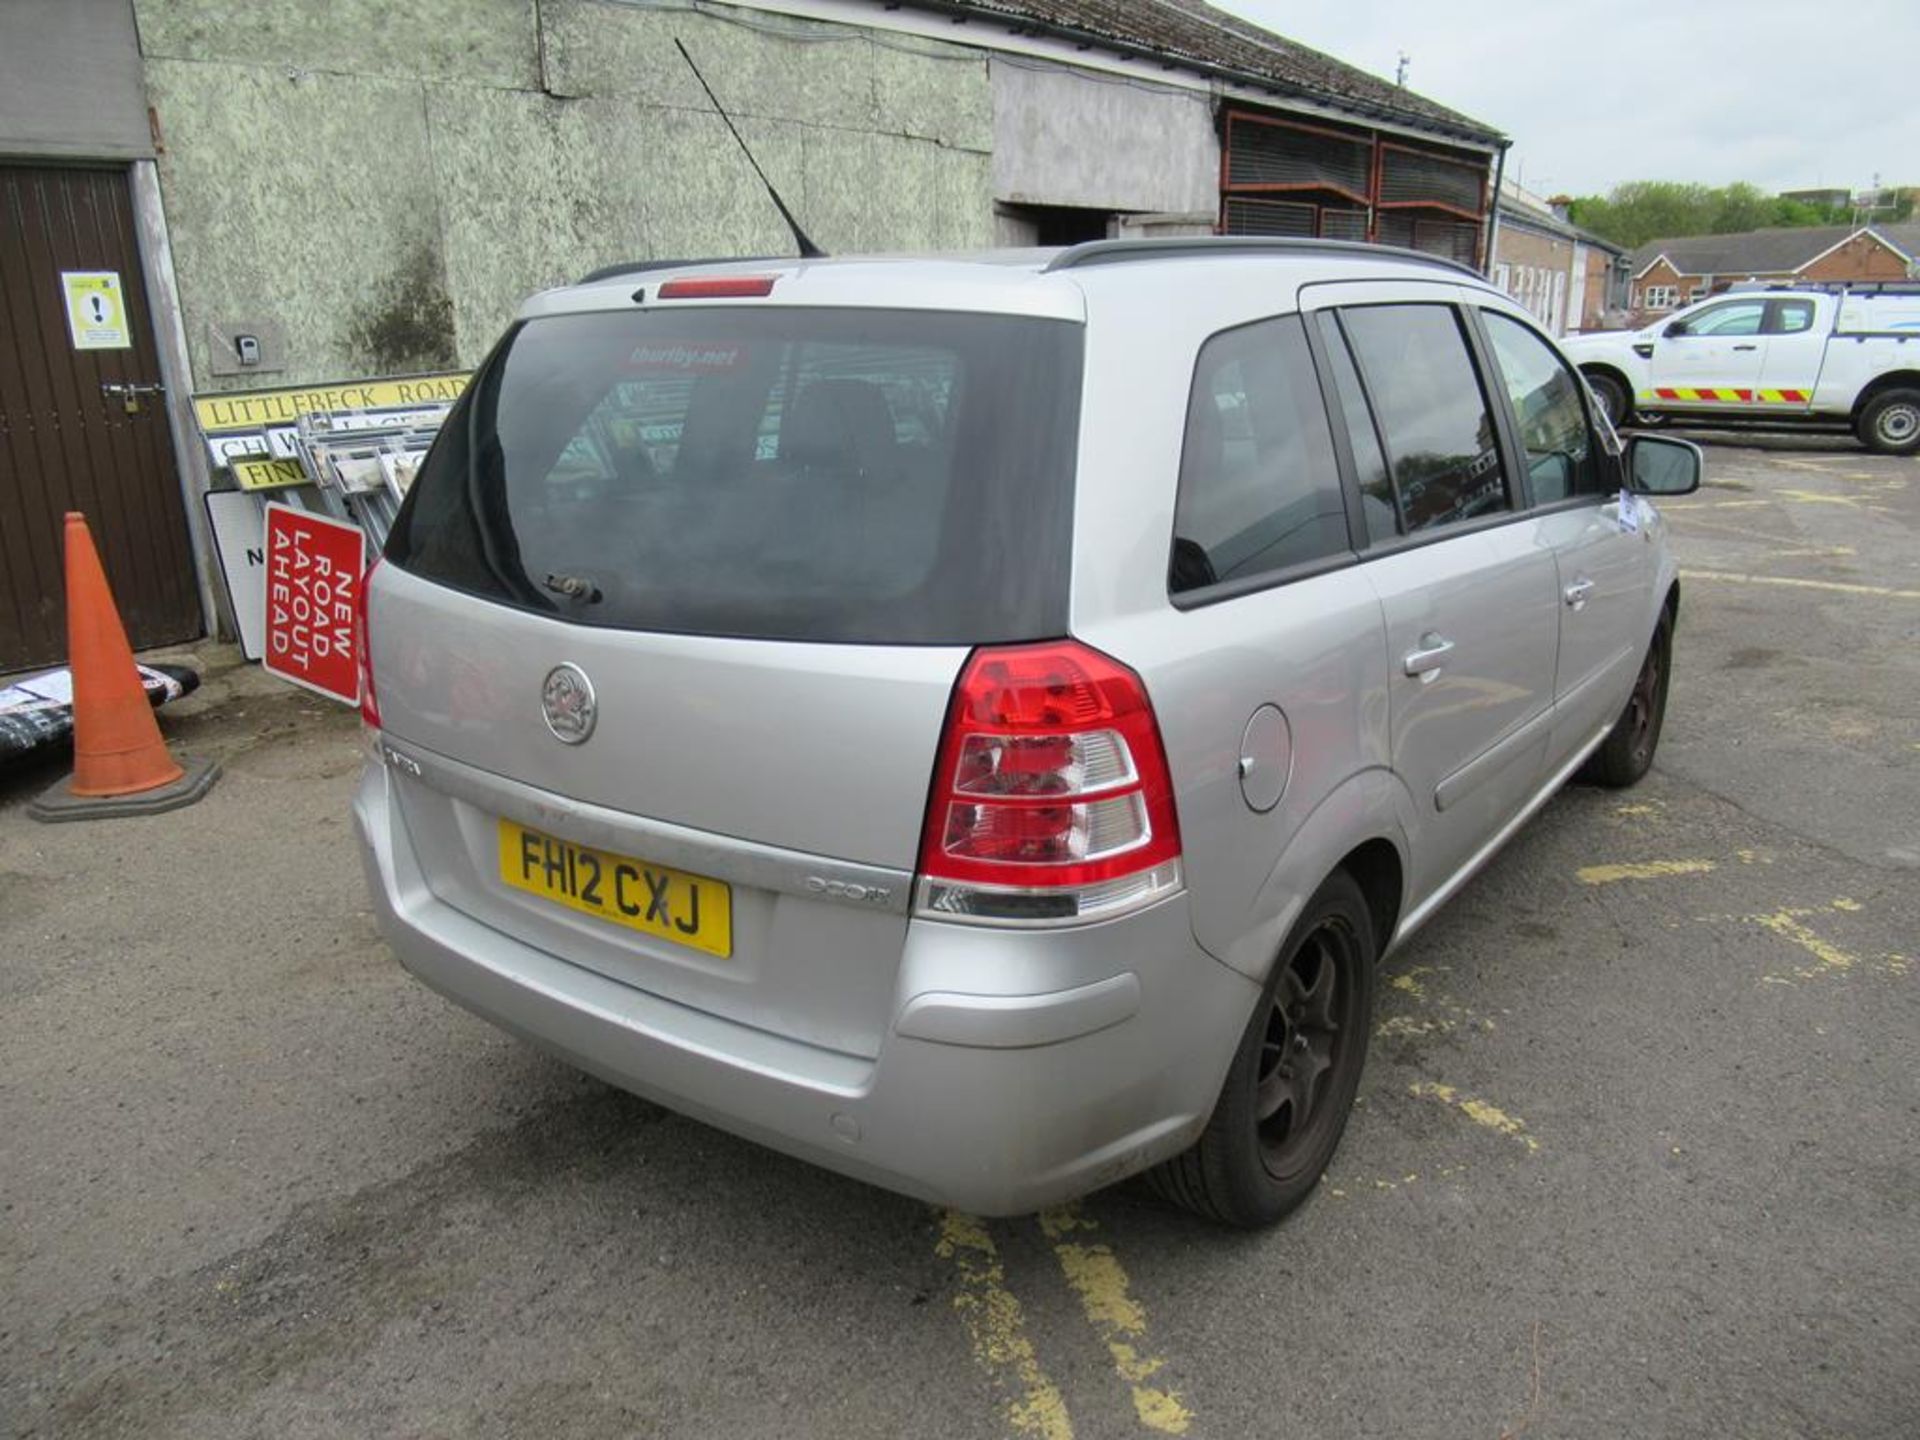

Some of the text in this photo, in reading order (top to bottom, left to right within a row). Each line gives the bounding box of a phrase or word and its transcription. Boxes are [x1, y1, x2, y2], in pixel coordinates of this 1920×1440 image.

[210, 387, 377, 425] LITTLEBECK
[397, 378, 467, 404] ROAD
[272, 528, 291, 654] AHEAD
[292, 530, 312, 671] LAYOUT
[313, 555, 331, 657] ROAD
[334, 570, 353, 658] NEW
[520, 830, 699, 936] FH12 CXJ
